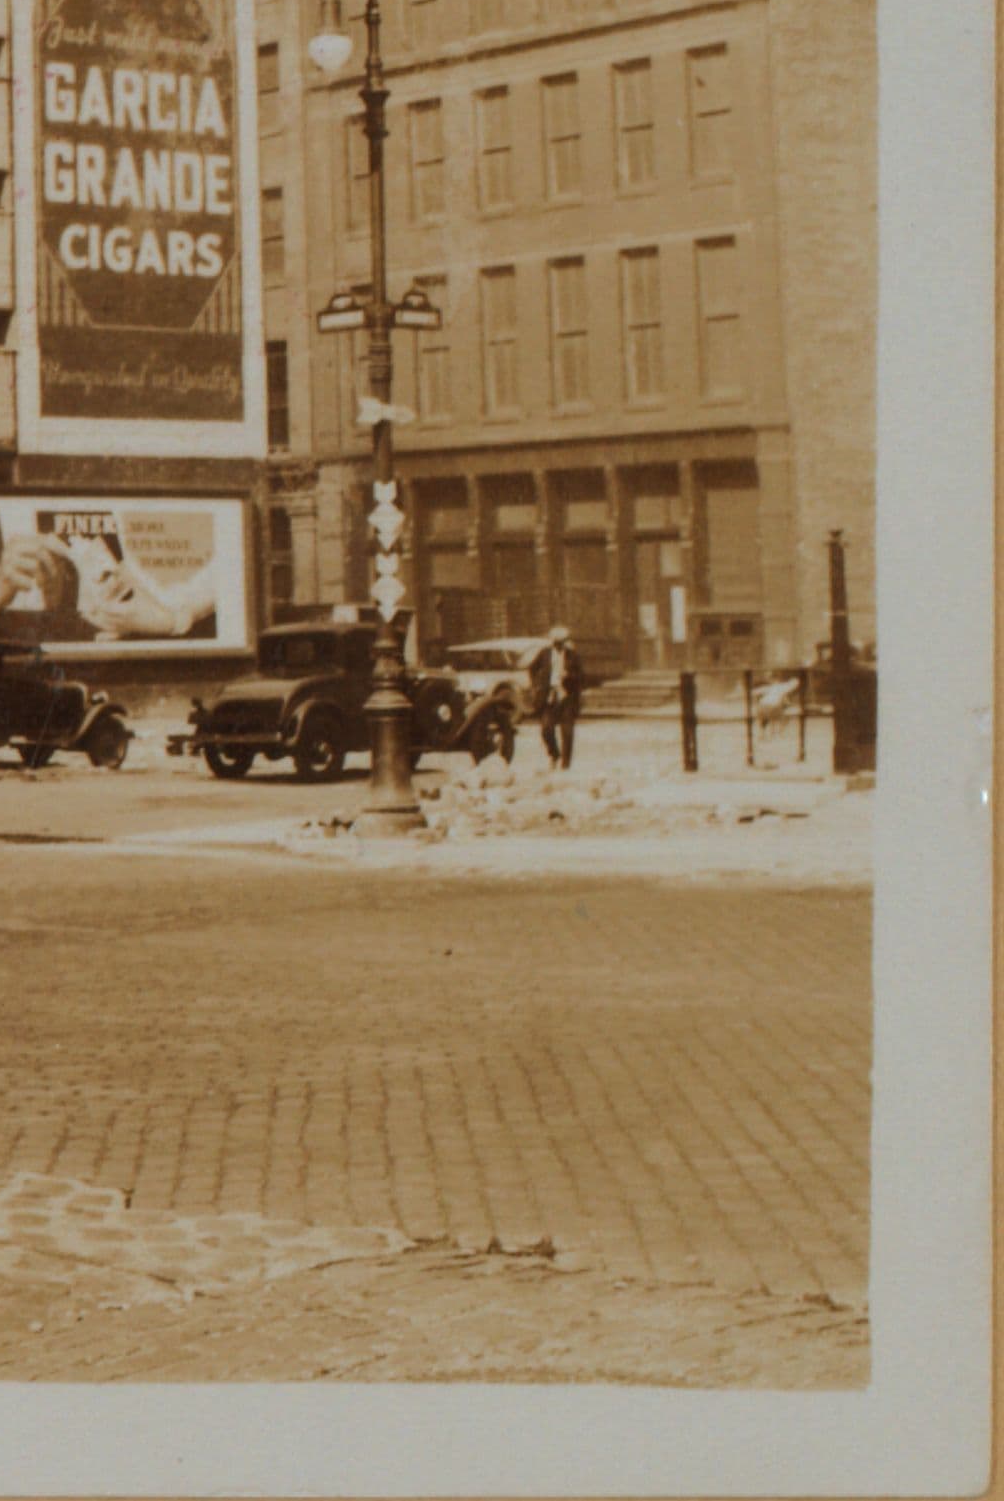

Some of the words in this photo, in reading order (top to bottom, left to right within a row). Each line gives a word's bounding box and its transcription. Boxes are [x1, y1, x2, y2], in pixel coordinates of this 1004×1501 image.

[46, 15, 99, 49] Just
[43, 61, 228, 139] GARCIA
[43, 140, 232, 216] GRANDE
[58, 224, 224, 278] CIGARS
